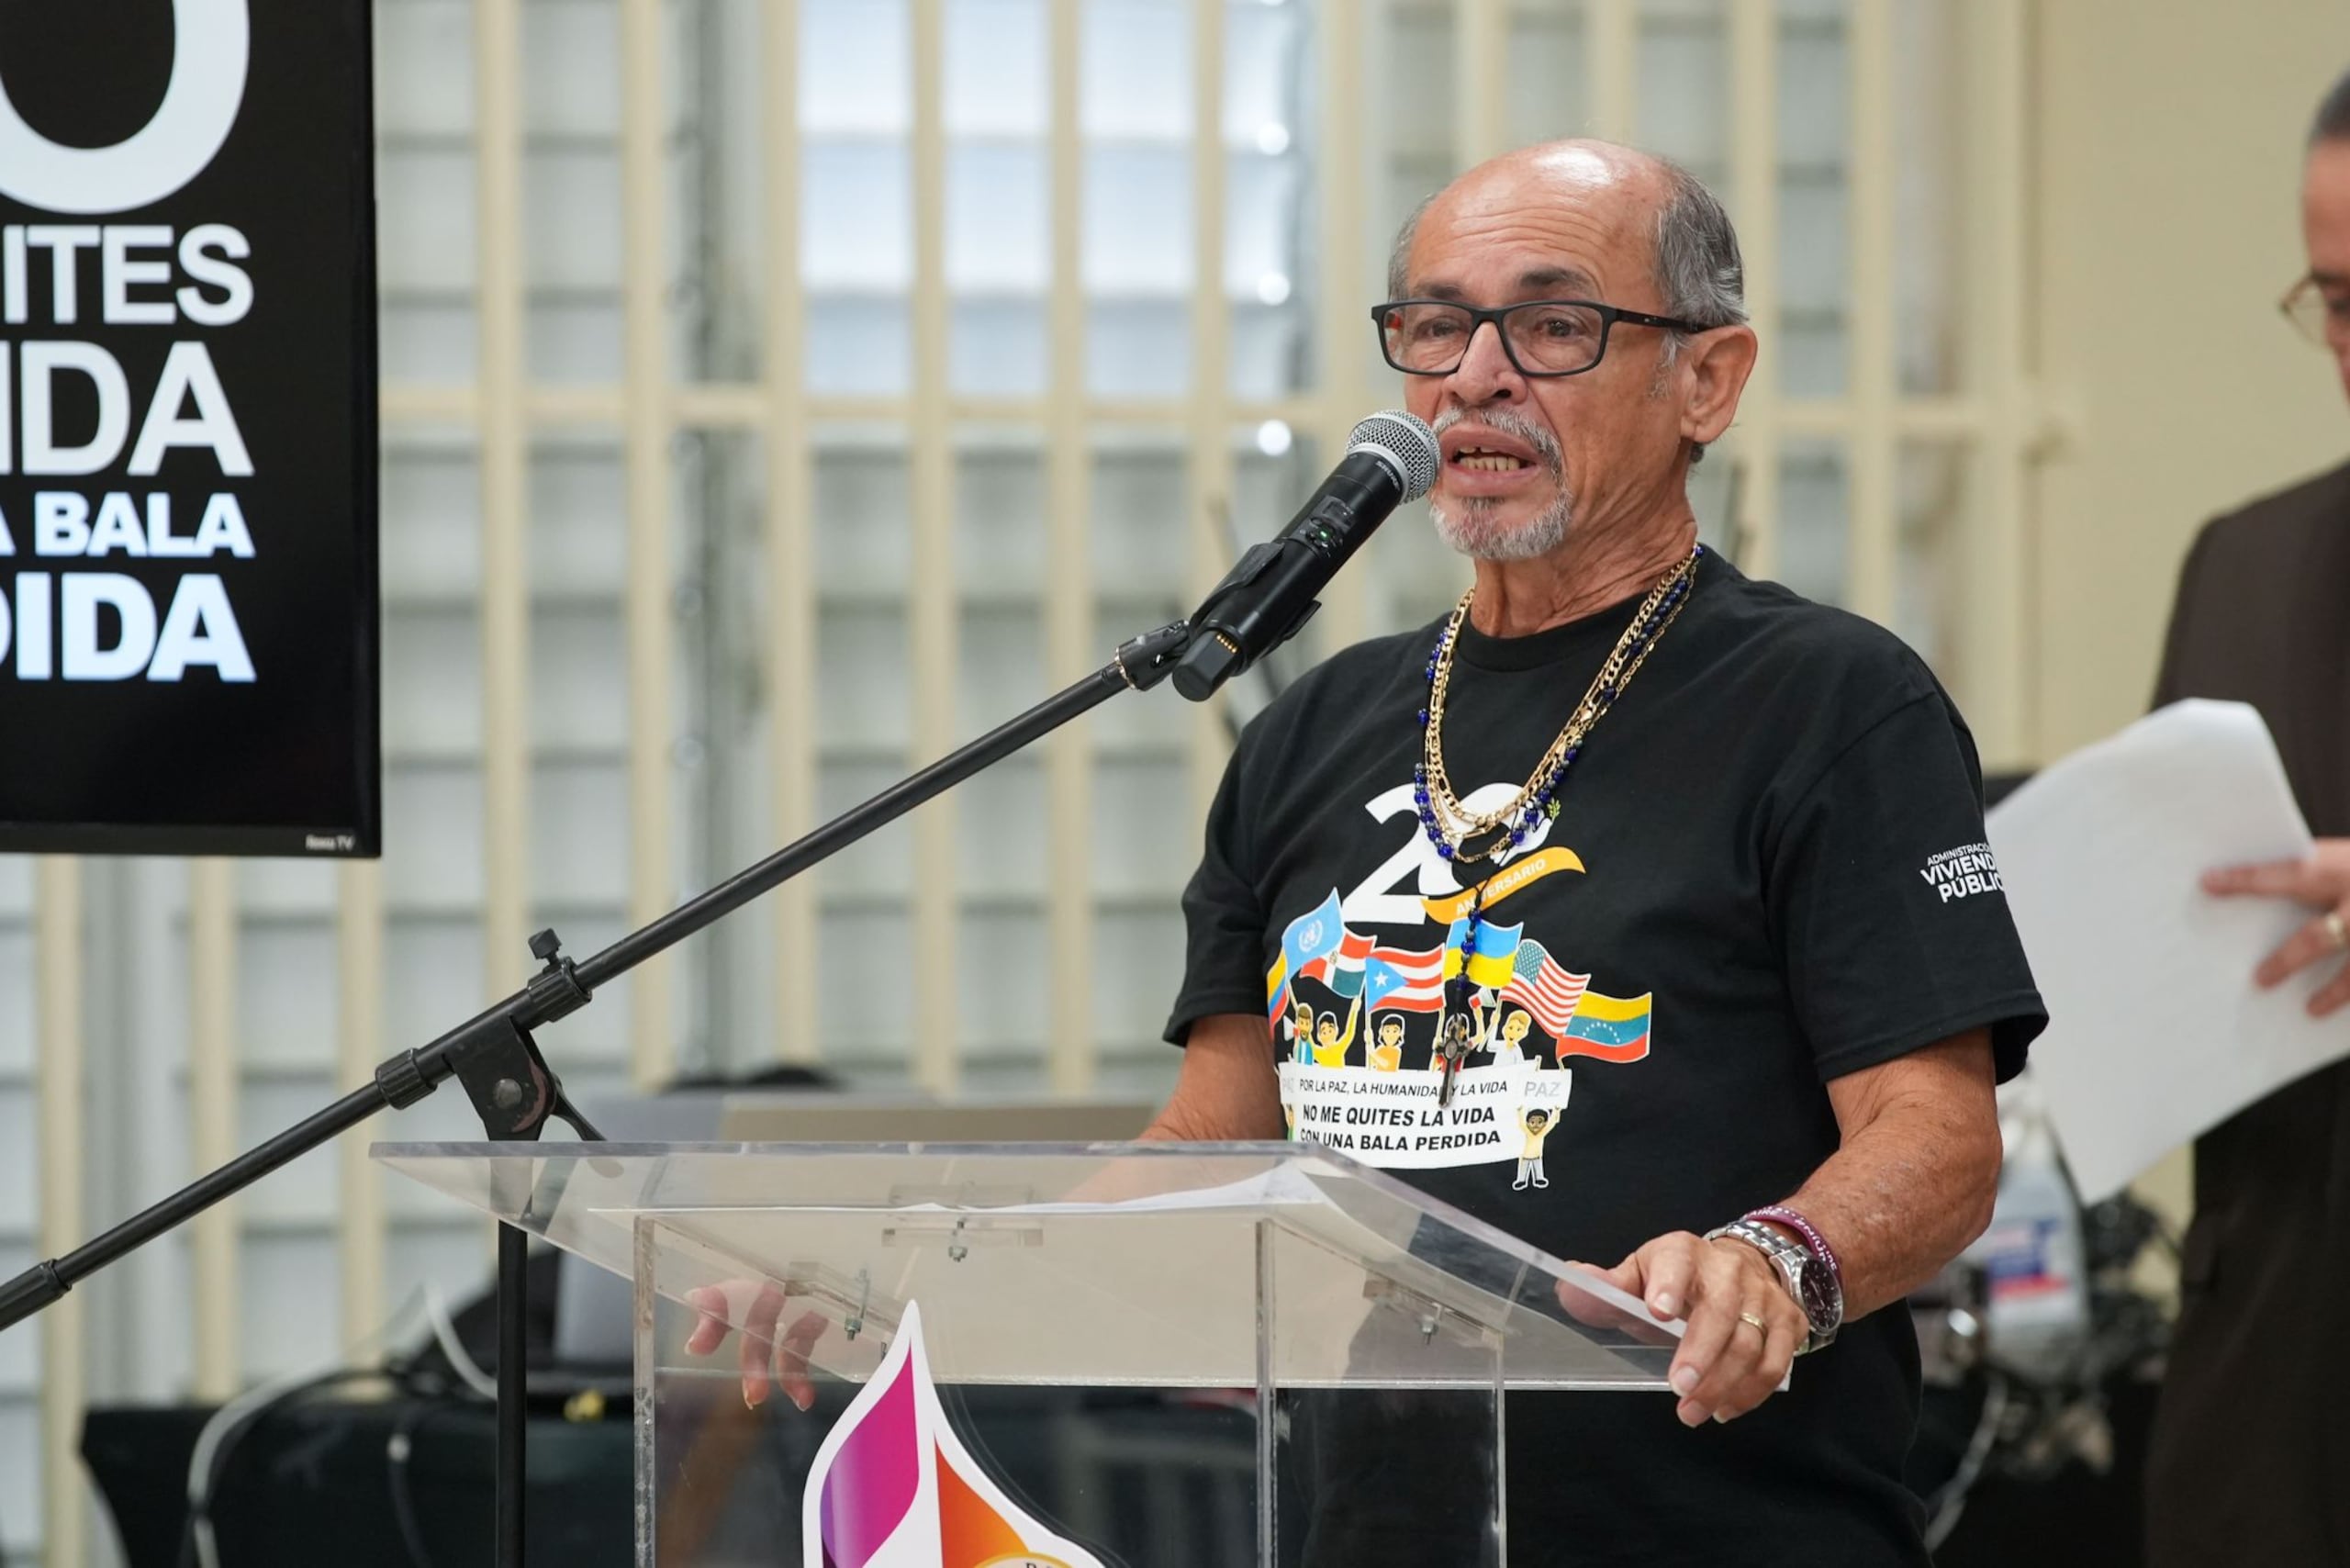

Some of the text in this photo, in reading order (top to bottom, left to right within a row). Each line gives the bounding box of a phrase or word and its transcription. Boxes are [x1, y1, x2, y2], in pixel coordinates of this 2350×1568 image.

[35, 491, 256, 557] BALA
[0, 571, 258, 682] IDA
[1456, 858, 1546, 916] ANVERSARIO
[1299, 1079, 1507, 1097] POR LA PAZ, LA HUMANIDA Y LA VIDA
[1524, 1081, 1561, 1098] PAZ
[1304, 1104, 1495, 1126] NO ME QUITES LA VIDA
[1300, 1128, 1501, 1150] CON UNA BALA PERDIDA
